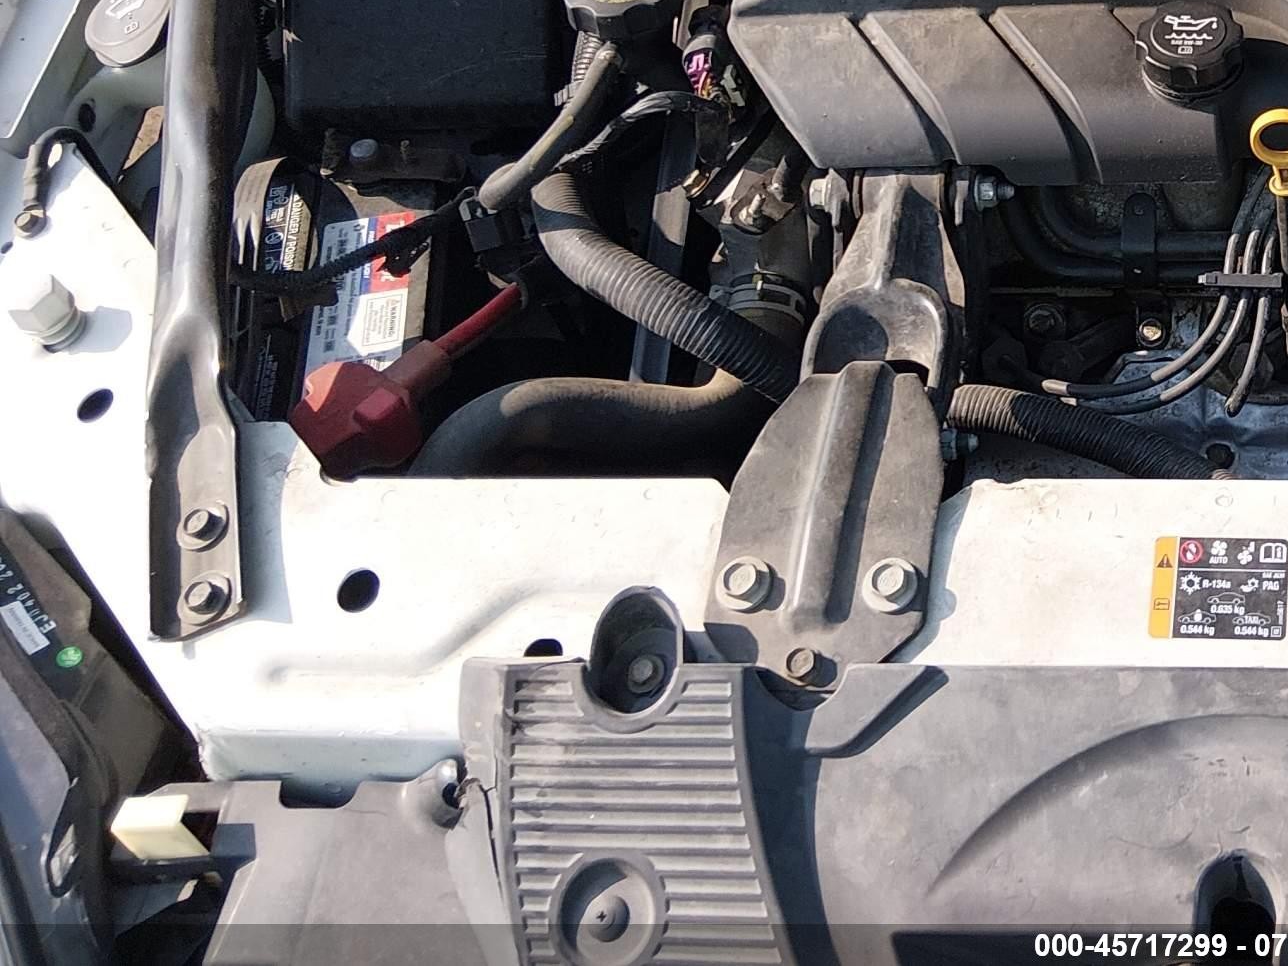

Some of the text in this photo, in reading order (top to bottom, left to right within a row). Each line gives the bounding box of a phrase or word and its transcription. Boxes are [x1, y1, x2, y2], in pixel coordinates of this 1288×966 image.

[288, 202, 303, 234] DANGER
[283, 241, 297, 271] POISON
[1209, 556, 1228, 564] AUTO
[1202, 579, 1231, 589] R-134a
[1262, 580, 1279, 590] PAG
[1233, 604, 1245, 615] kg
[1180, 625, 1215, 636] 0.544 kg
[1234, 625, 1258, 635] 0.544
[1258, 626, 1269, 637] kg
